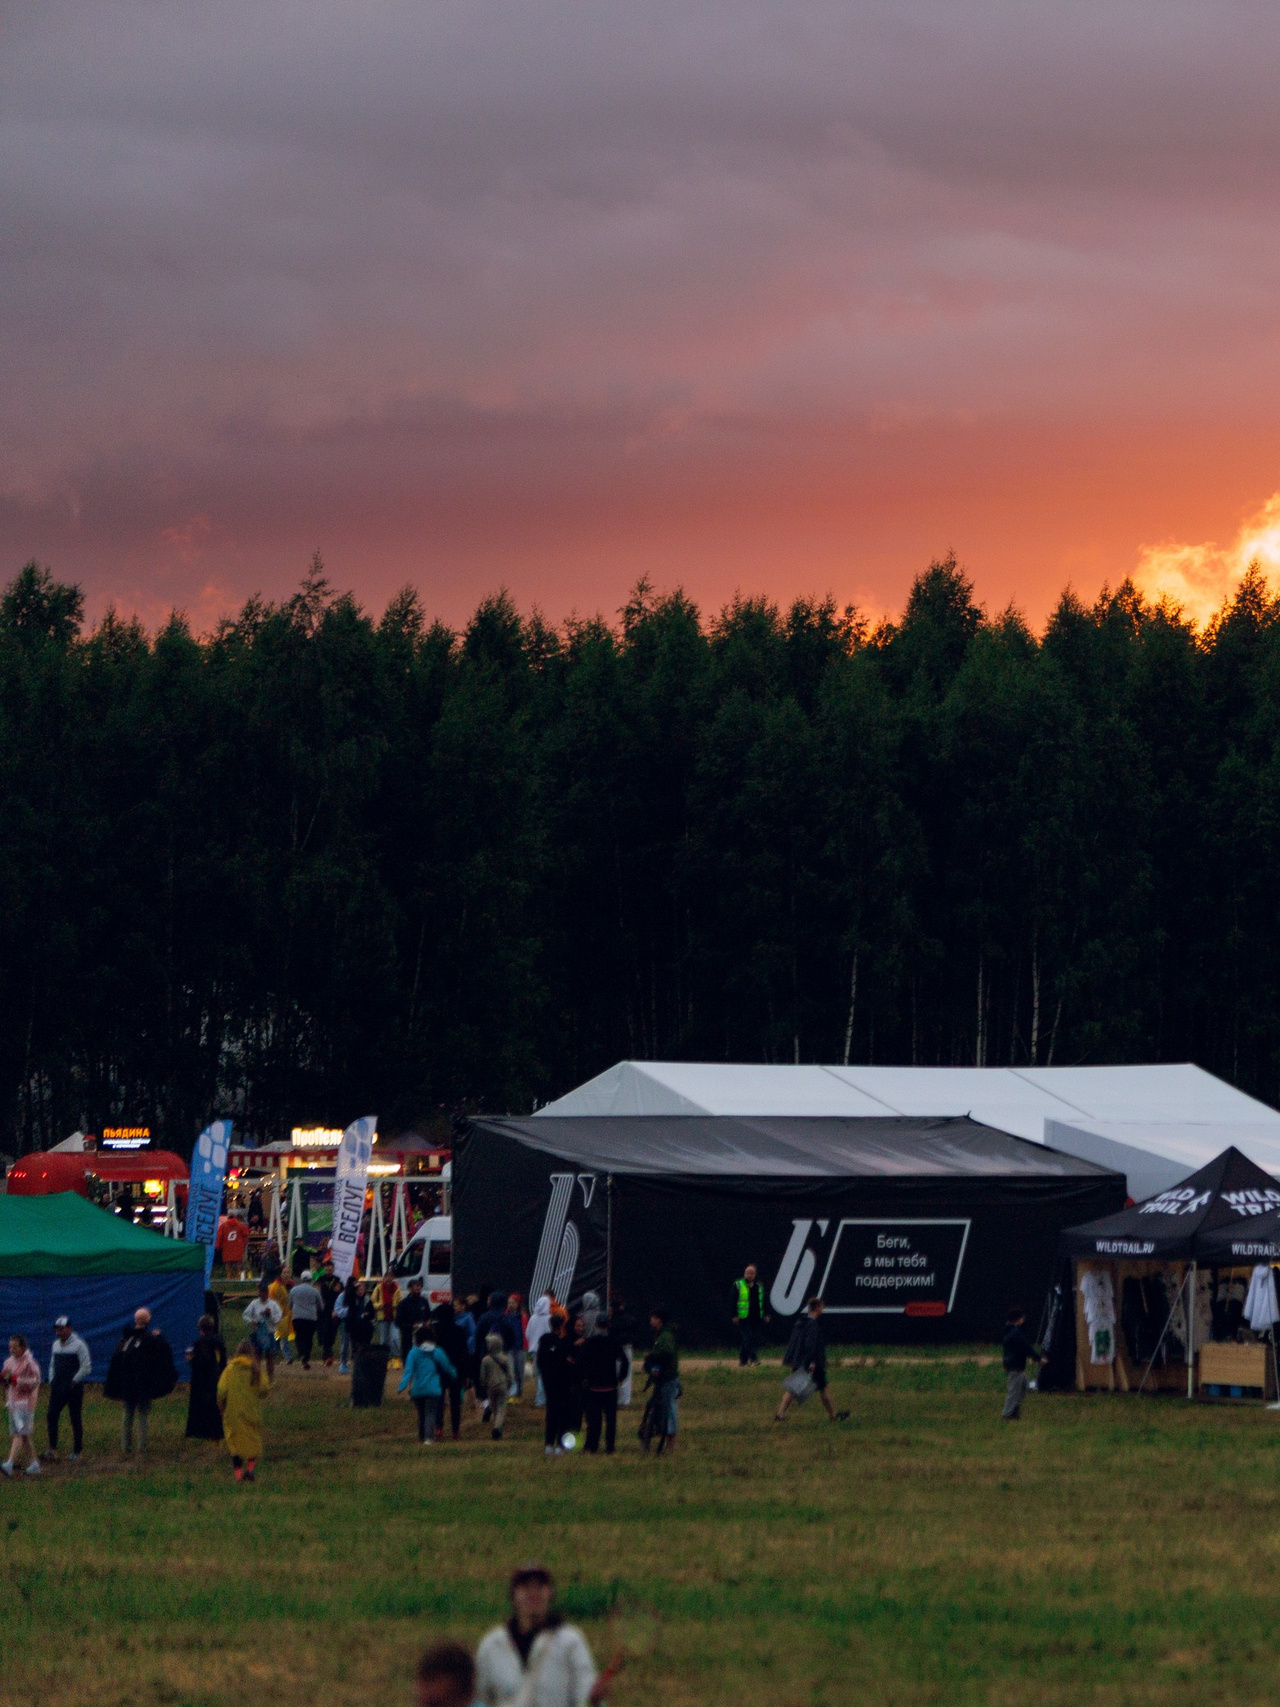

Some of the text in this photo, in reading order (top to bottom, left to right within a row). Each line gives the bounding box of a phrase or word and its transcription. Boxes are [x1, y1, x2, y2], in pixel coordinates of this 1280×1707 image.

[103, 1127, 150, 1139] ПЬЯДИНА
[338, 1180, 365, 1245] ВСЕЛУГ
[877, 1234, 911, 1250] Беги,
[1096, 1241, 1155, 1254] WILDTRAIL.RU
[864, 1253, 927, 1267] а мы тебя
[855, 1273, 935, 1289] поддержим!
